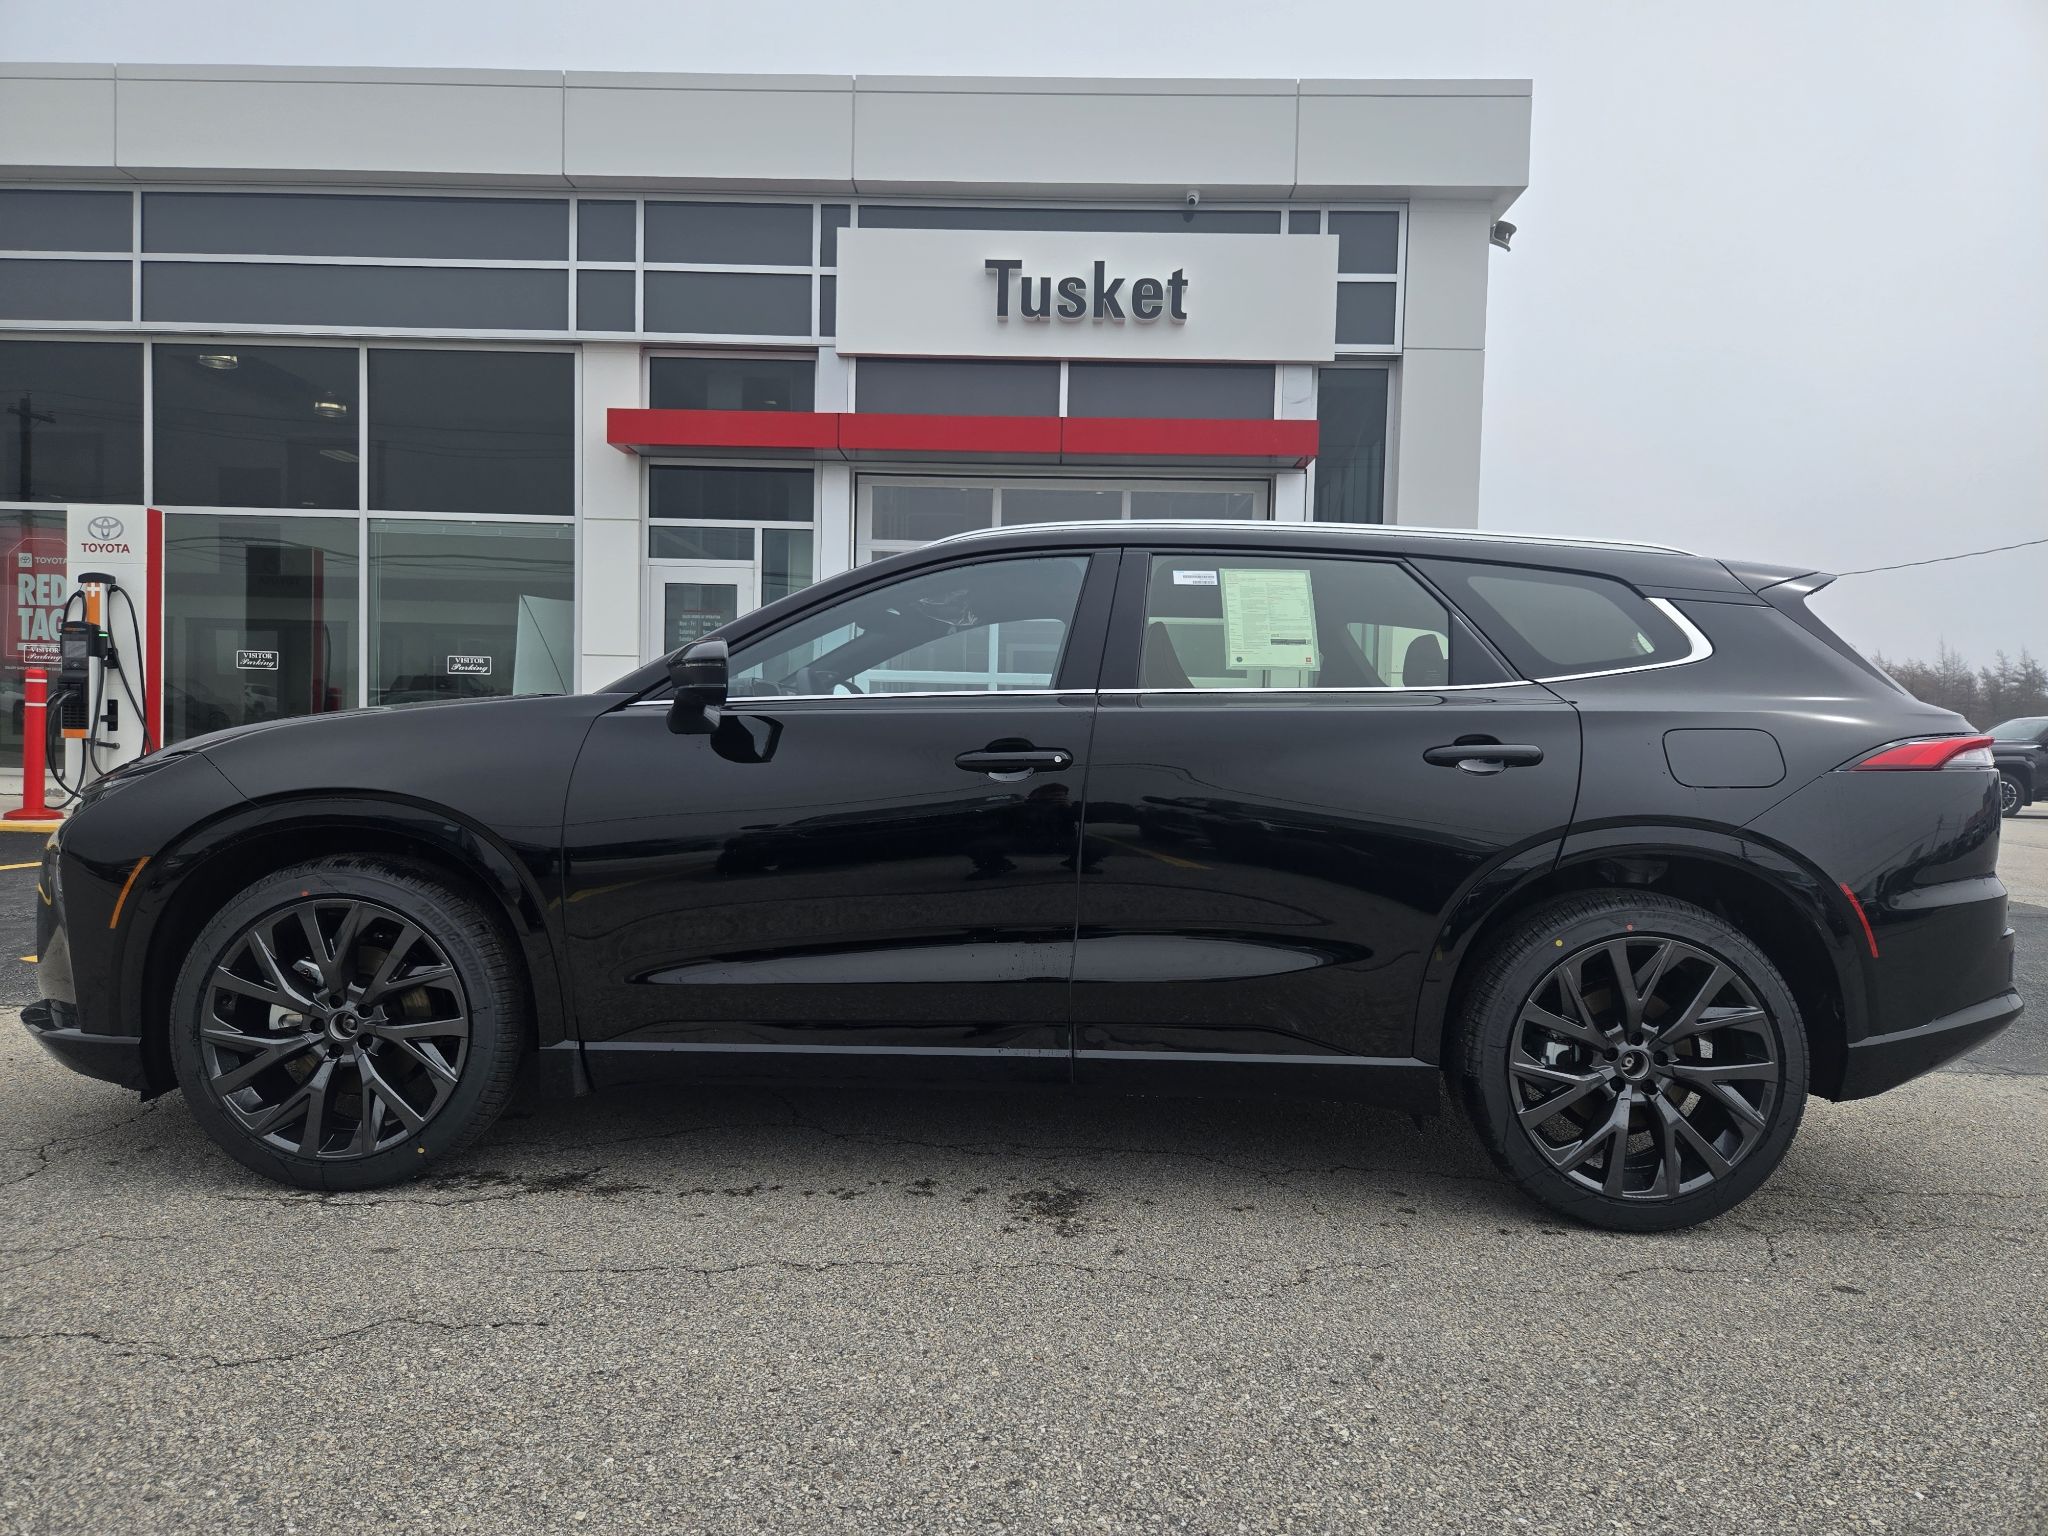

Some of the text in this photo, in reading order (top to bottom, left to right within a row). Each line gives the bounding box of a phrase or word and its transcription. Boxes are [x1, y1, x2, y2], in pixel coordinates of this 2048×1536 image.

[985, 259, 1189, 321] Tusket
[81, 543, 130, 554] TOYOTA
[18, 573, 67, 606] RED
[240, 658, 275, 667] Parking
[451, 663, 488, 673] Parking
